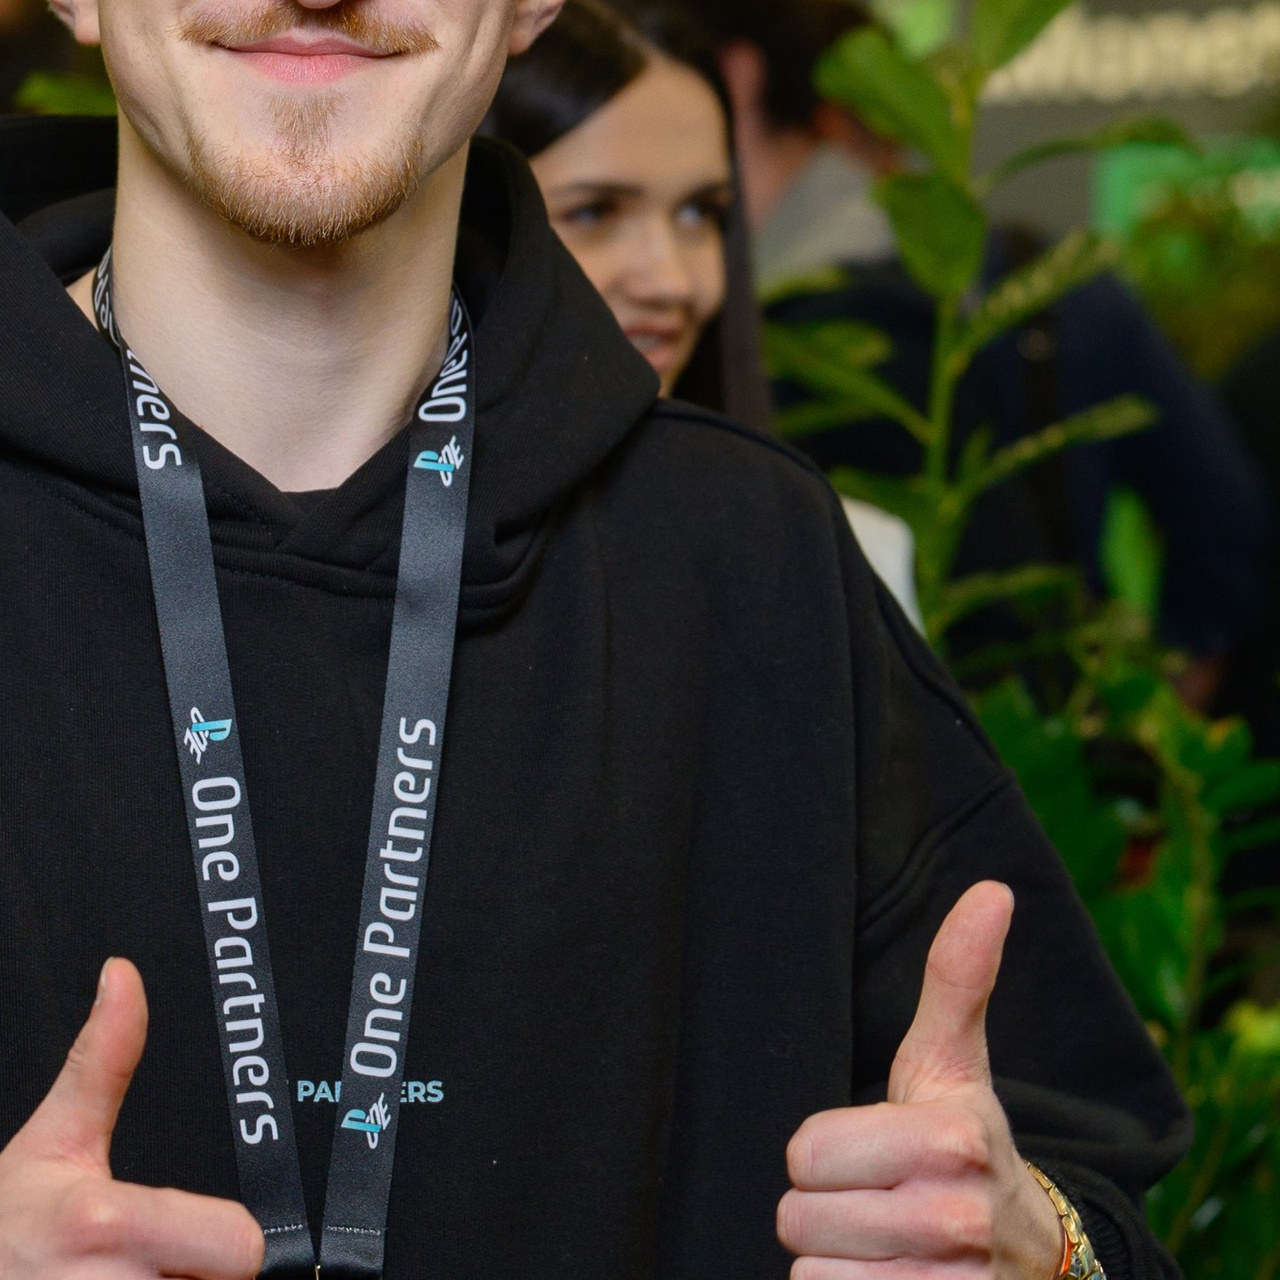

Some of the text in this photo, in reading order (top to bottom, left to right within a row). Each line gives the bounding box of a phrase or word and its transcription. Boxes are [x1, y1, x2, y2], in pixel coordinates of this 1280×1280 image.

[191, 776, 279, 1145] One Partners
[349, 716, 437, 1078] One Partners
